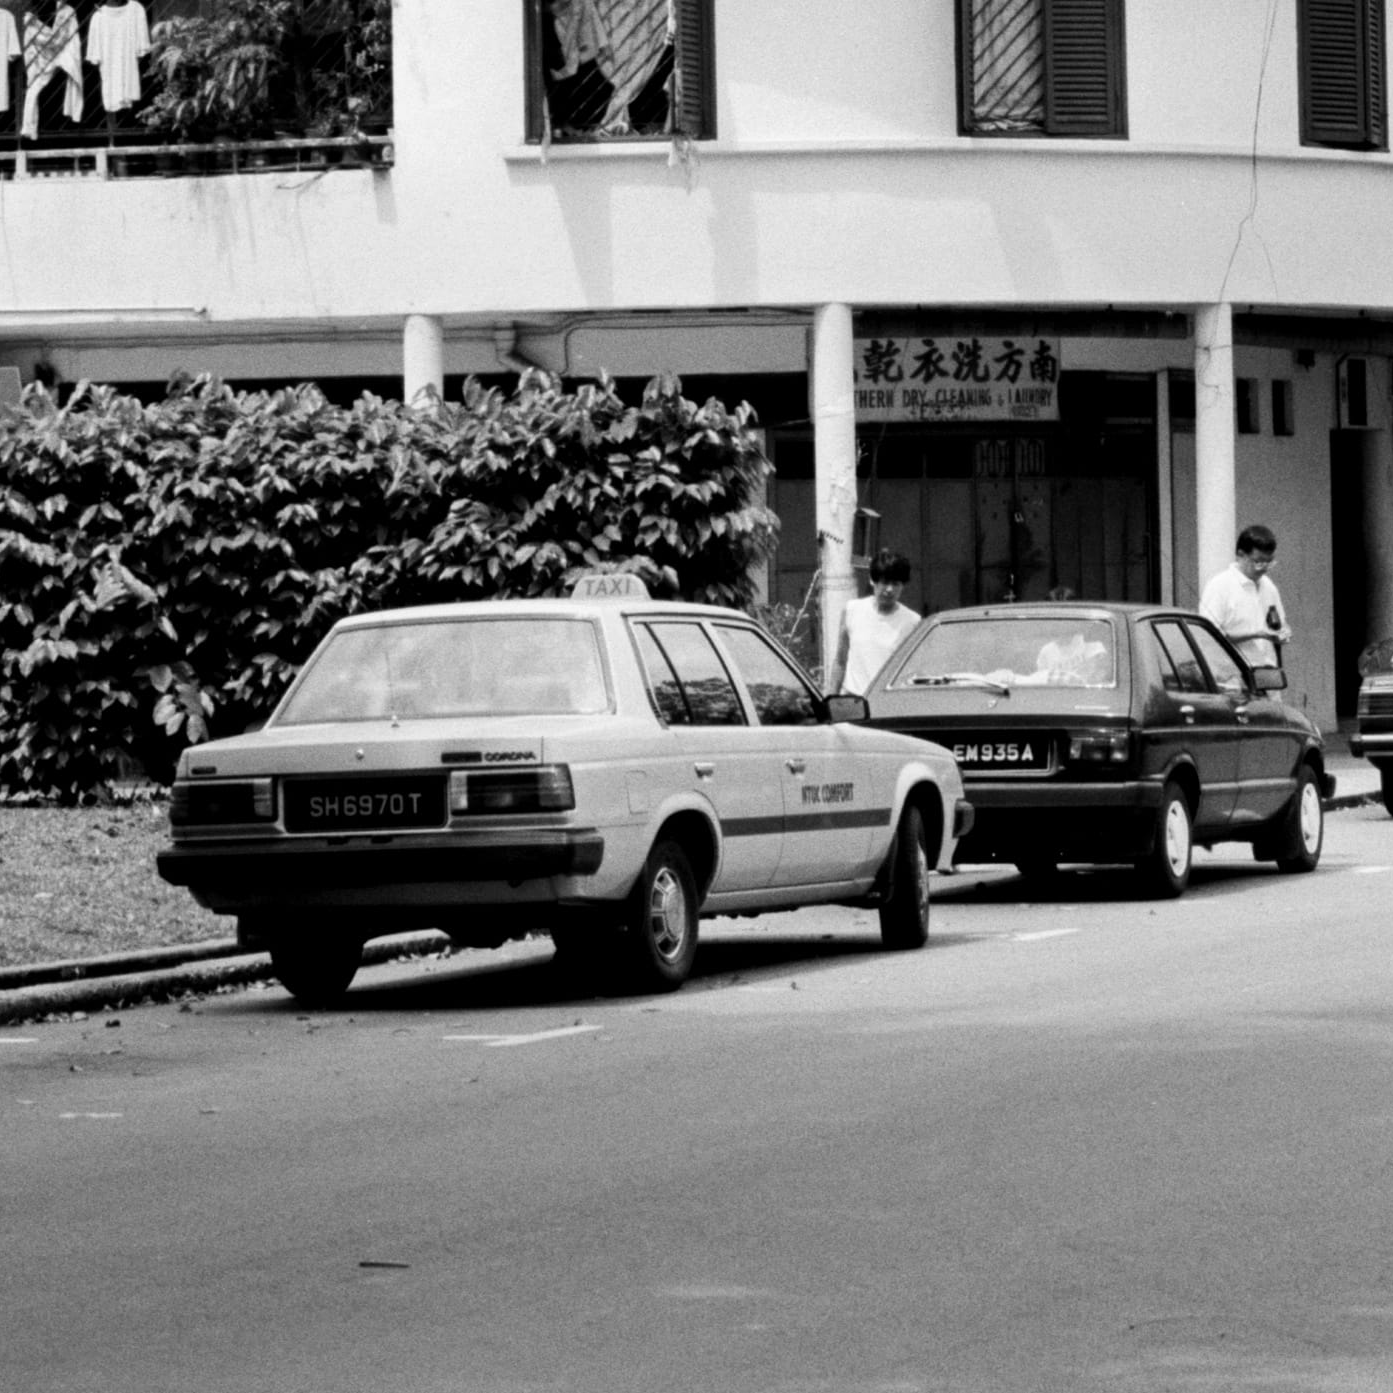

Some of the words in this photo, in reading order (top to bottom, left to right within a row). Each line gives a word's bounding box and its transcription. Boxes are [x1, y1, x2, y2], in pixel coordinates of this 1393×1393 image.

[903, 389, 927, 408] DRY
[935, 388, 992, 406] CLEANING
[1008, 387, 1053, 406] LAUNDRY
[584, 578, 631, 596] TAXI
[485, 751, 537, 762] CORONA
[309, 792, 423, 818] SH6970T
